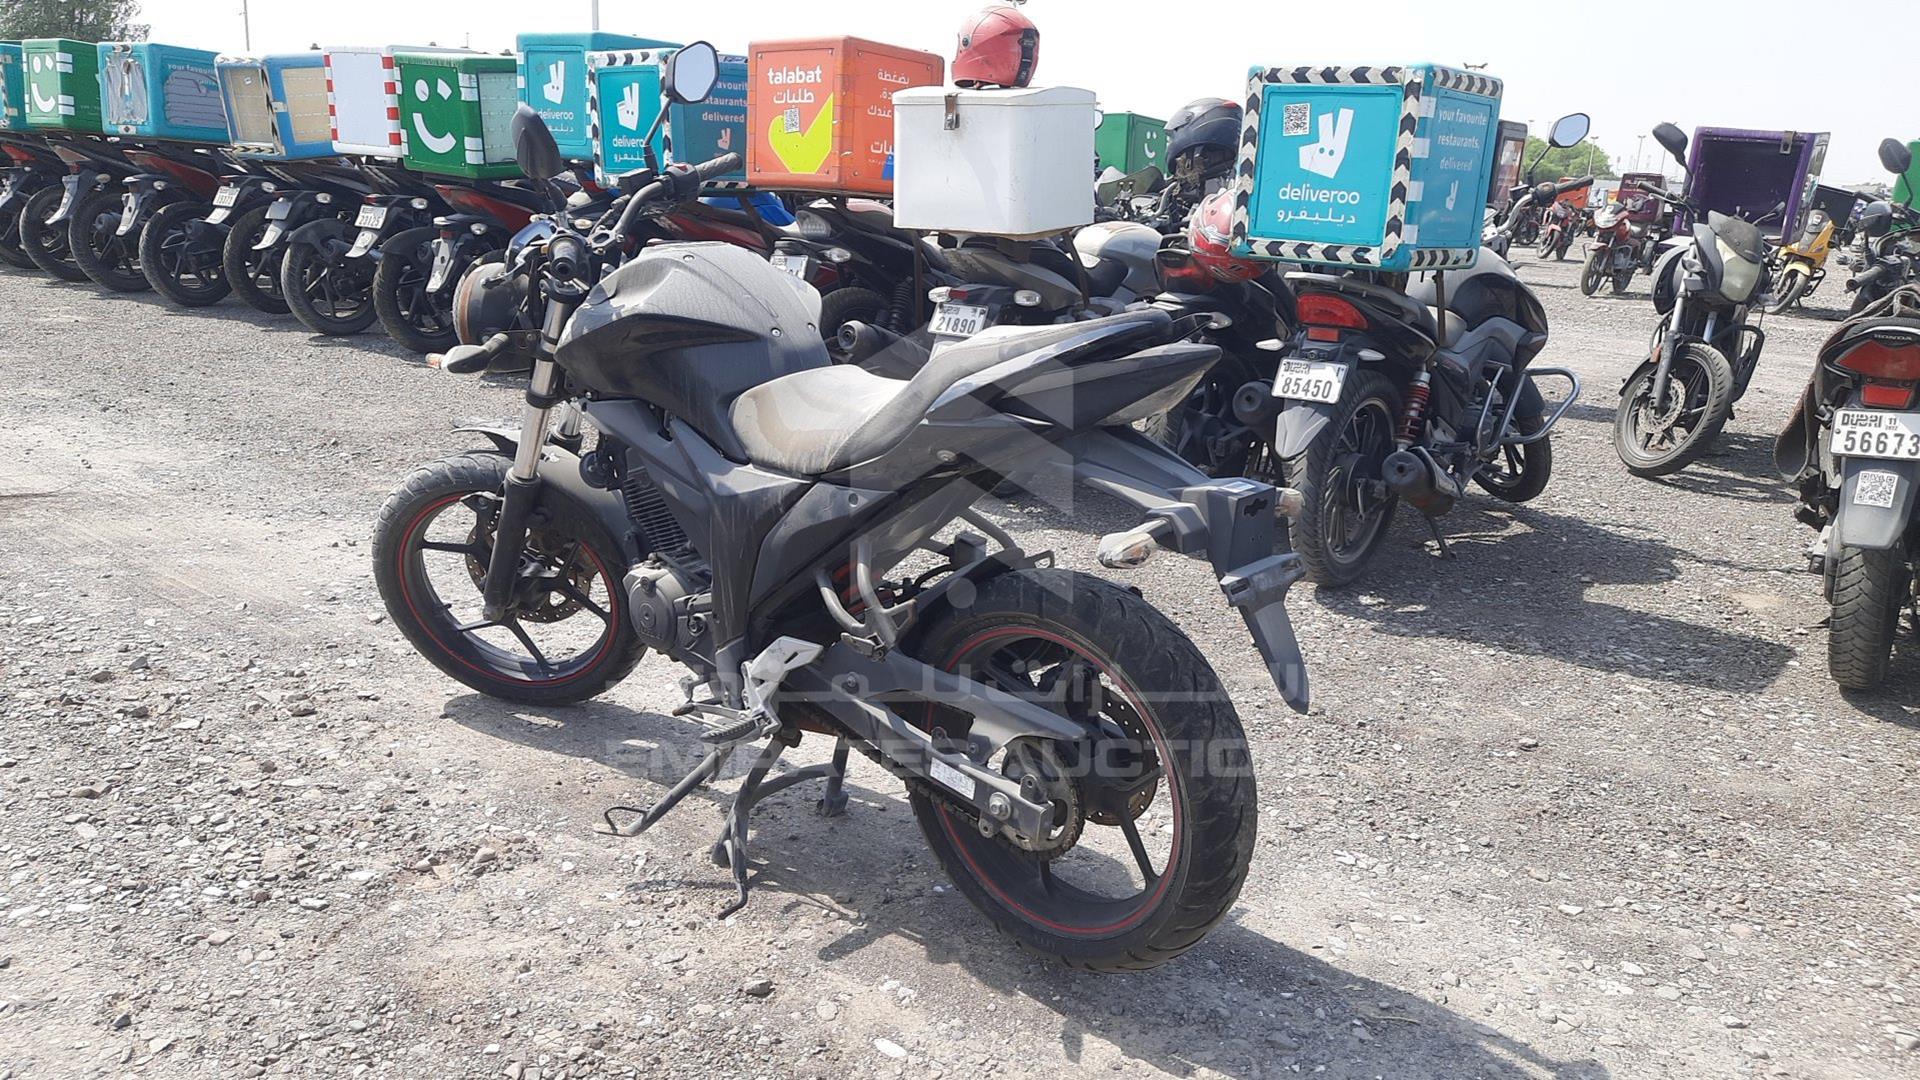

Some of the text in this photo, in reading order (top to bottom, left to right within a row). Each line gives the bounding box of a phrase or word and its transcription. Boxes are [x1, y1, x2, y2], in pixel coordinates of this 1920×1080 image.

[767, 65, 822, 85] talabat
[714, 81, 748, 91] avourit
[773, 89, 814, 109] طلبات
[702, 112, 745, 123] delivered
[1438, 109, 1487, 126] your favourite
[612, 134, 645, 148] delivero
[1440, 157, 1472, 172] delivered
[1278, 182, 1360, 205] deliveroo
[1276, 206, 1356, 227] ديليفرو
[936, 316, 976, 334] 21890
[1281, 377, 1332, 399] 85450
[1843, 430, 1920, 457] 56673
